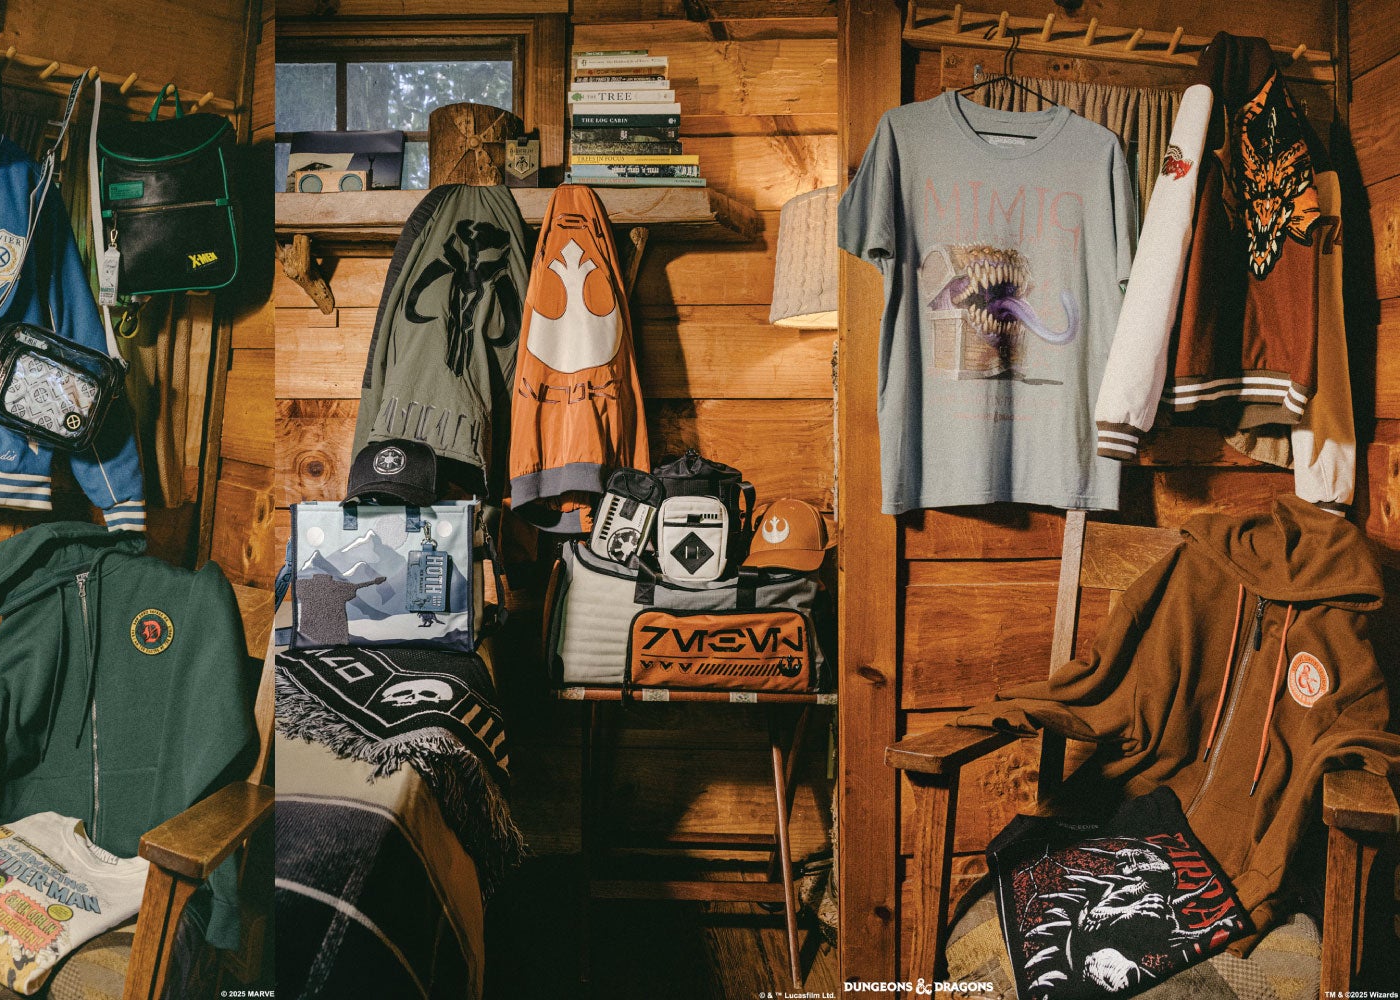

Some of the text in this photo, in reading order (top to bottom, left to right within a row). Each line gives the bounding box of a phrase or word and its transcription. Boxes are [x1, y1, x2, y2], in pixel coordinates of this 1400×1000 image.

[598, 92, 632, 100] TREE
[188, 252, 218, 269] X-MEN
[425, 555, 443, 594] HOTH
[17, 851, 88, 893] AMAZING
[5, 895, 31, 915] GREEN
[26, 910, 59, 934] GOBLIN
